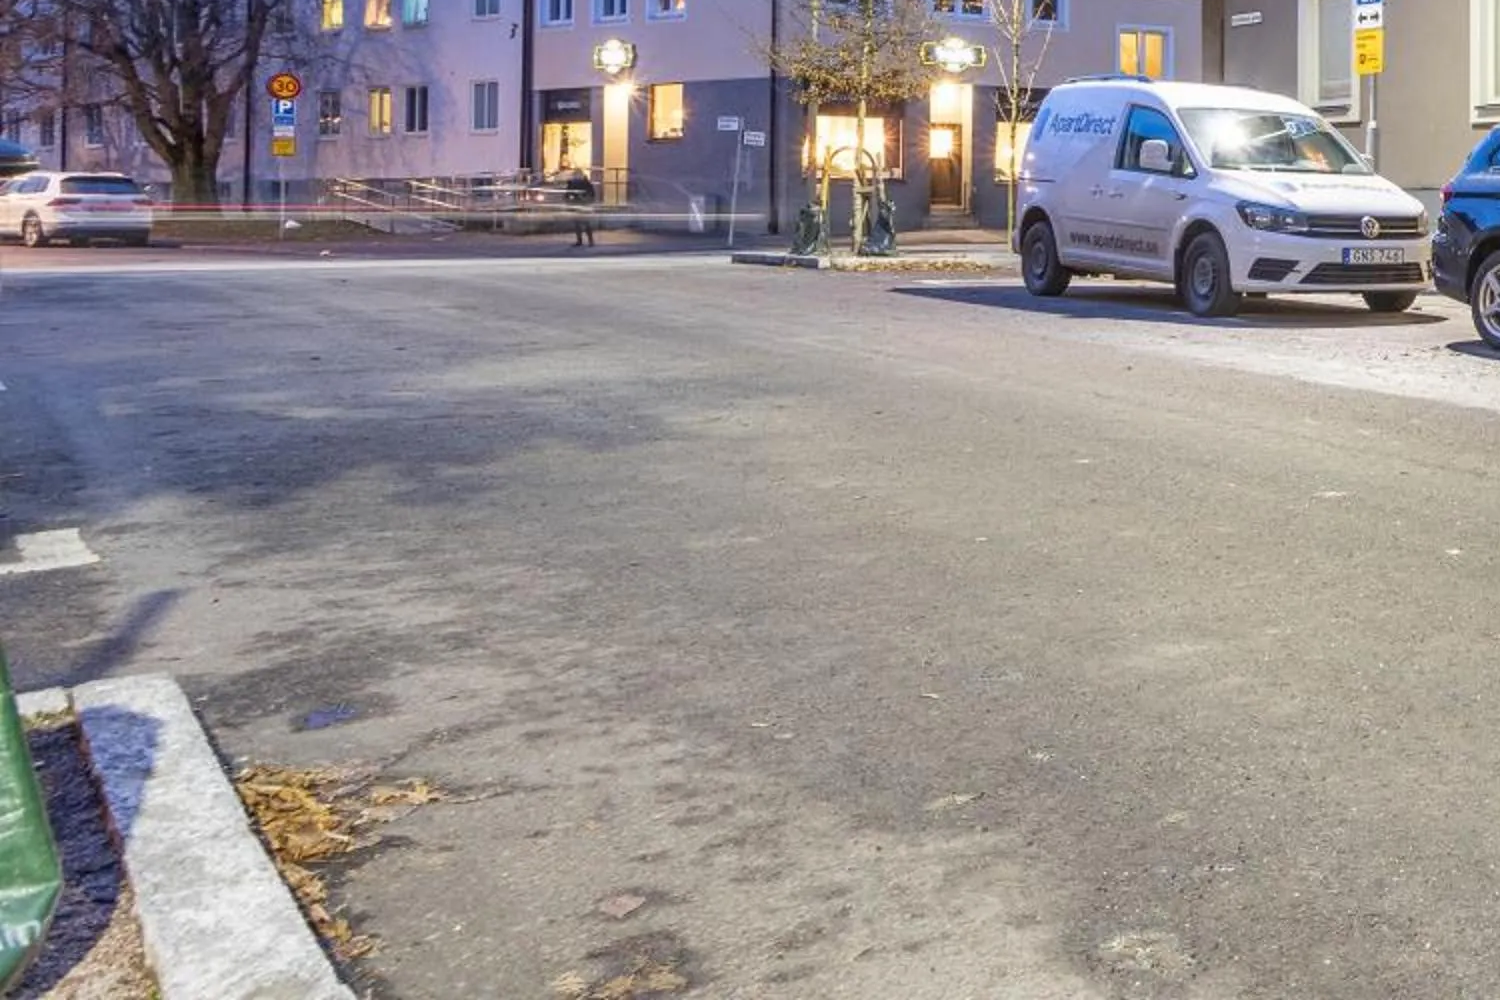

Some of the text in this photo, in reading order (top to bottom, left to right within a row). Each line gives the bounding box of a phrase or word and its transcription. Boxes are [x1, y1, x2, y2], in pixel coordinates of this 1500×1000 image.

[276, 79, 297, 93] 30
[279, 99, 293, 113] P
[1048, 112, 1116, 136] ApartDirect
